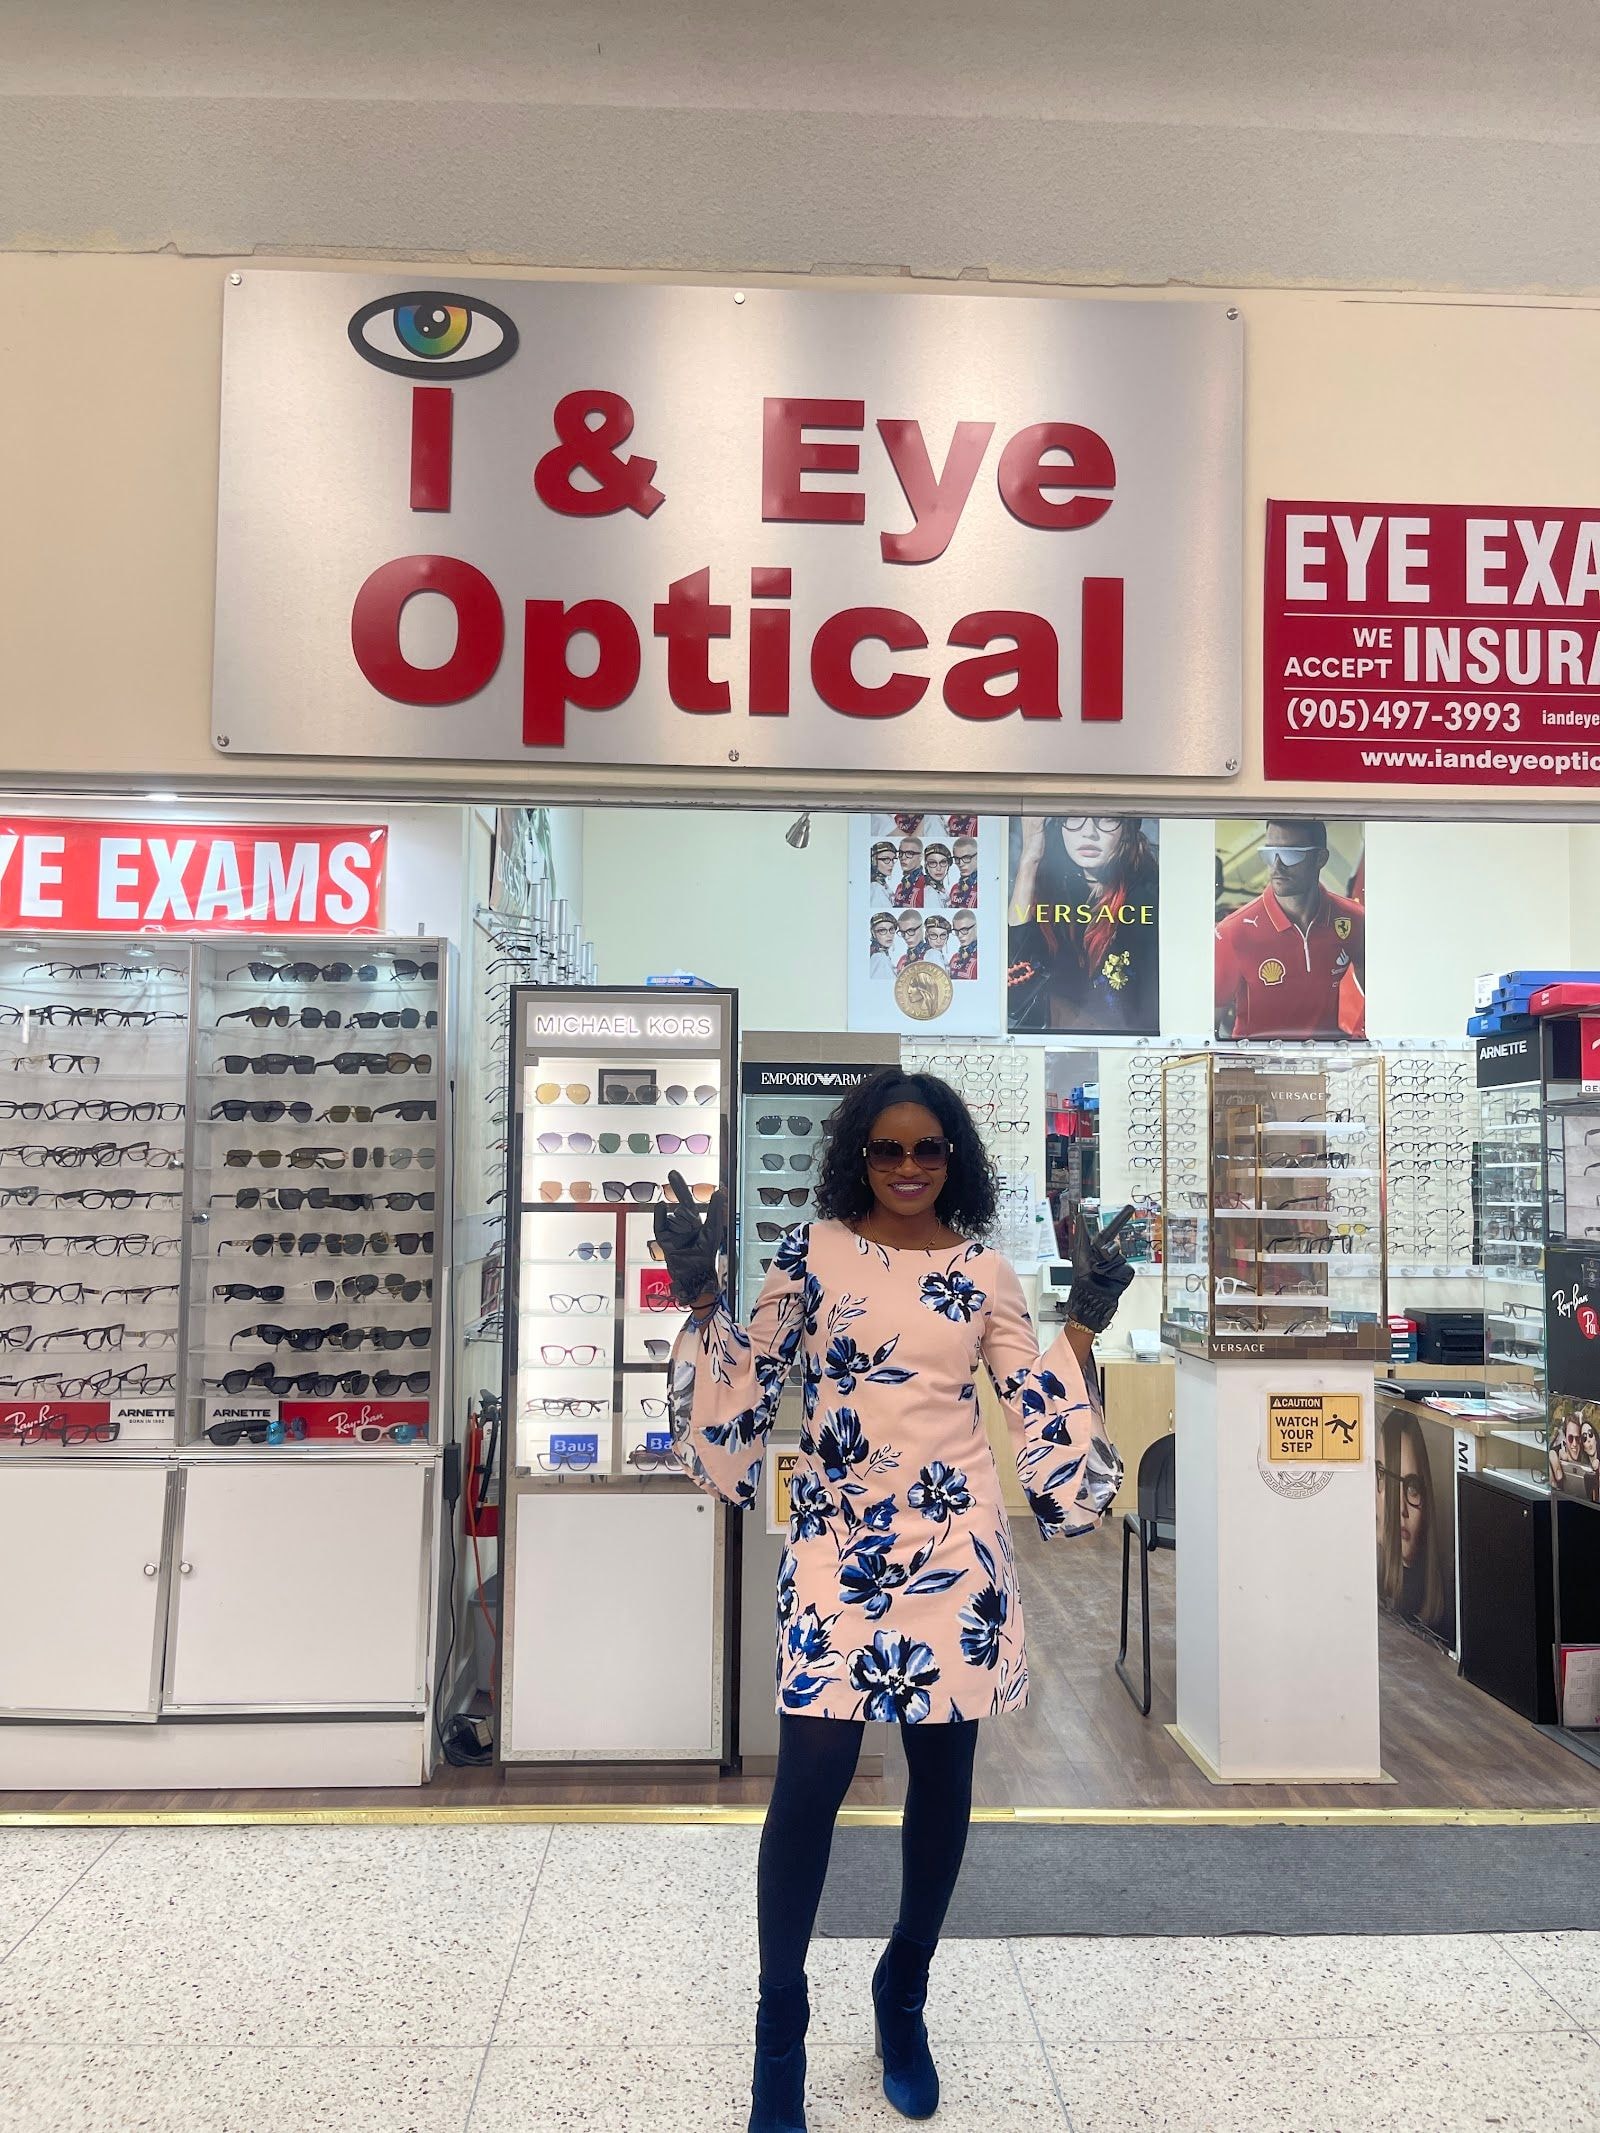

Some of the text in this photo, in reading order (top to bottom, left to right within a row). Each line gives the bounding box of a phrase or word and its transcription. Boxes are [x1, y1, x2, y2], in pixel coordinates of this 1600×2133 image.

[410, 386, 1117, 565] I & Eye
[1285, 514, 1600, 606] EYE EXA
[1352, 627, 1393, 649] WE
[350, 553, 1125, 747] Optical
[1283, 656, 1393, 679] ACCEPT
[1286, 697, 1521, 732] (905)497-3993
[1360, 748, 1600, 775] www.iandeyeoptic
[97, 837, 373, 926] EXAMS
[1014, 903, 1155, 925] VERSACE
[535, 1016, 713, 1035] MICHAEL KORS
[1480, 1040, 1528, 1060] ARNETTE
[760, 1072, 873, 1086] EMPORIO ARM
[1270, 1091, 1325, 1101] VERSACE
[1212, 1343, 1265, 1353] VERSACE
[1281, 1398, 1321, 1407] CAUTION
[117, 1408, 175, 1417] ARNETTE
[212, 1408, 271, 1417] ARNETTE
[1275, 1416, 1319, 1427] WATCH
[1280, 1429, 1314, 1440] YOUR
[554, 1439, 595, 1452] Baus
[650, 1437, 673, 1451] Ba
[1281, 1442, 1313, 1453] STEP
